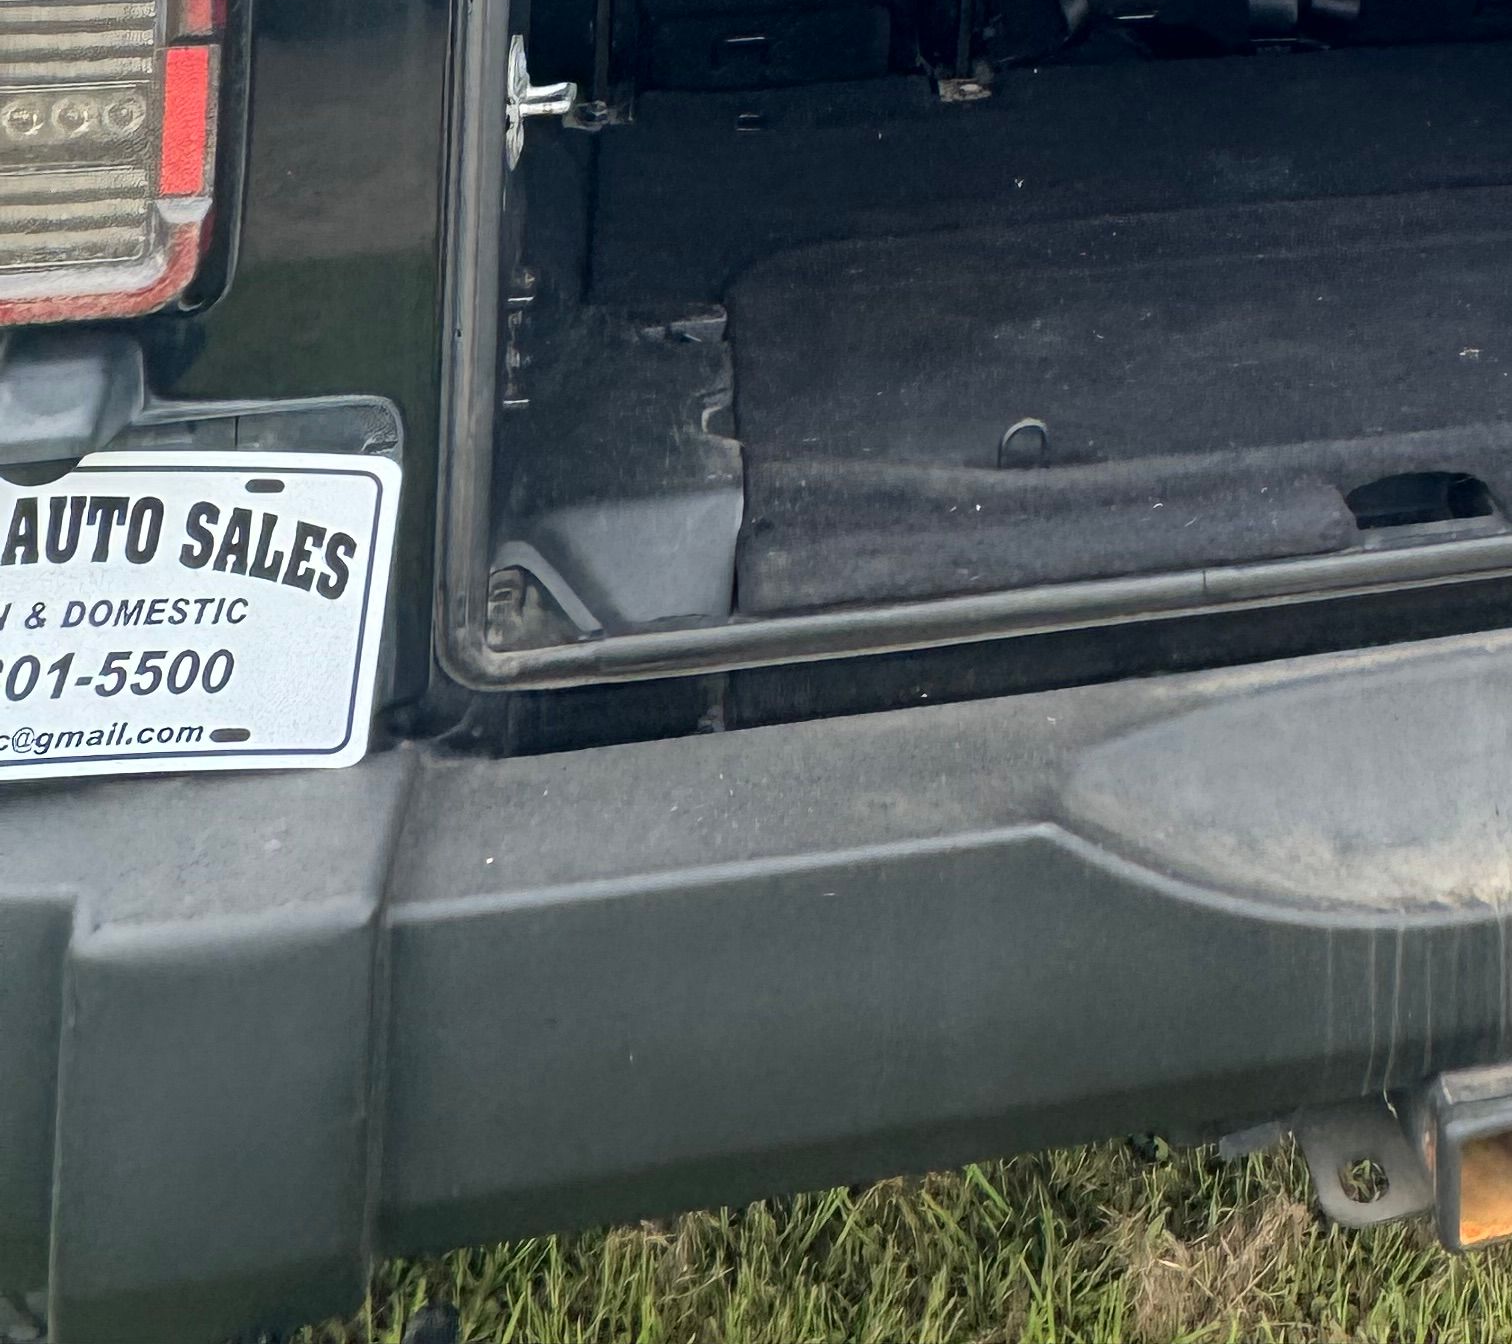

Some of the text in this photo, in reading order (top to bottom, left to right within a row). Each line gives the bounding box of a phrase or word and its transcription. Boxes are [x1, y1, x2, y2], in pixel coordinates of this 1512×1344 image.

[0, 496, 358, 600] AUTO SALES
[24, 601, 47, 630] &
[60, 598, 249, 629] DOMESTIC
[0, 648, 235, 702] 01-5500
